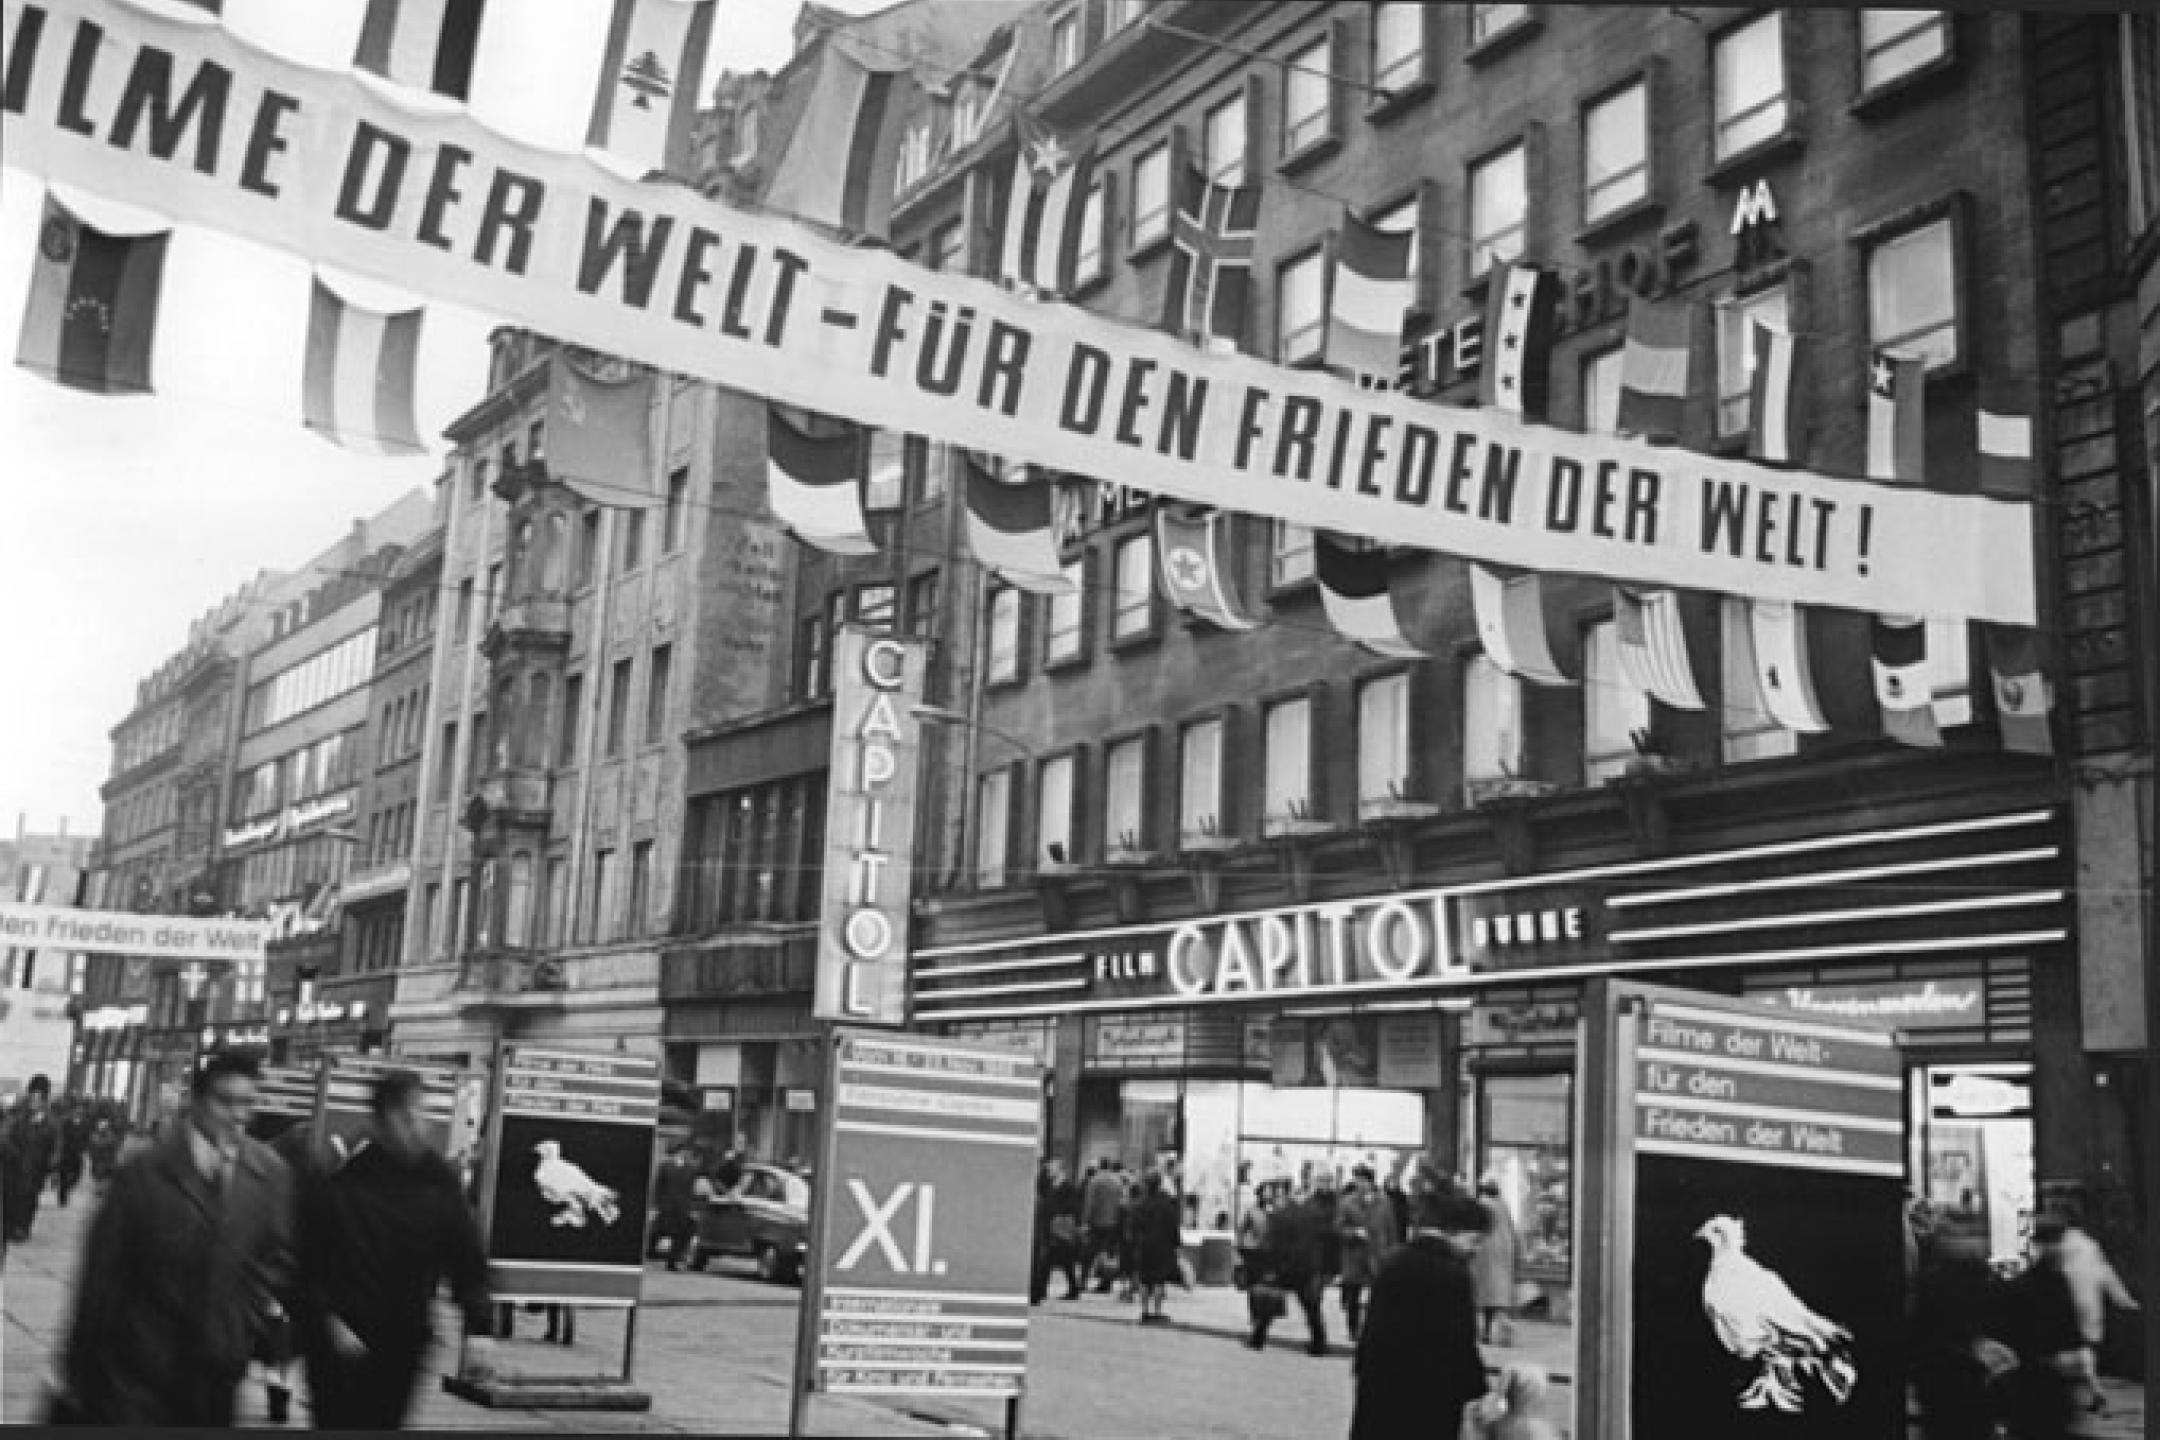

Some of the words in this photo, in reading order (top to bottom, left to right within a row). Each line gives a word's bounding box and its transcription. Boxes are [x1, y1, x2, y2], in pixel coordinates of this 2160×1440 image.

[335, 119, 545, 276] DER
[576, 195, 808, 347] WELT
[871, 284, 1032, 417] FÜR
[1059, 341, 1208, 462] DEN
[1233, 386, 1521, 524] FRIEDEN
[1545, 455, 1662, 546] DER
[846, 639, 905, 1015] CAPITOL
[0, 914, 38, 937] en
[48, 914, 146, 946] Frieden
[151, 924, 201, 948] der
[206, 926, 261, 951] Welt
[1167, 892, 1470, 995] CAPITOL
[1648, 1019, 1716, 1050] Filme
[1726, 1028, 1761, 1056] der
[1647, 1062, 1681, 1091] für
[1688, 1070, 1735, 1099] den
[1647, 1107, 1736, 1143] Frieden
[1746, 1121, 1783, 1146] der
[1791, 1121, 1843, 1154] Welt
[834, 1178, 948, 1275] XI.
